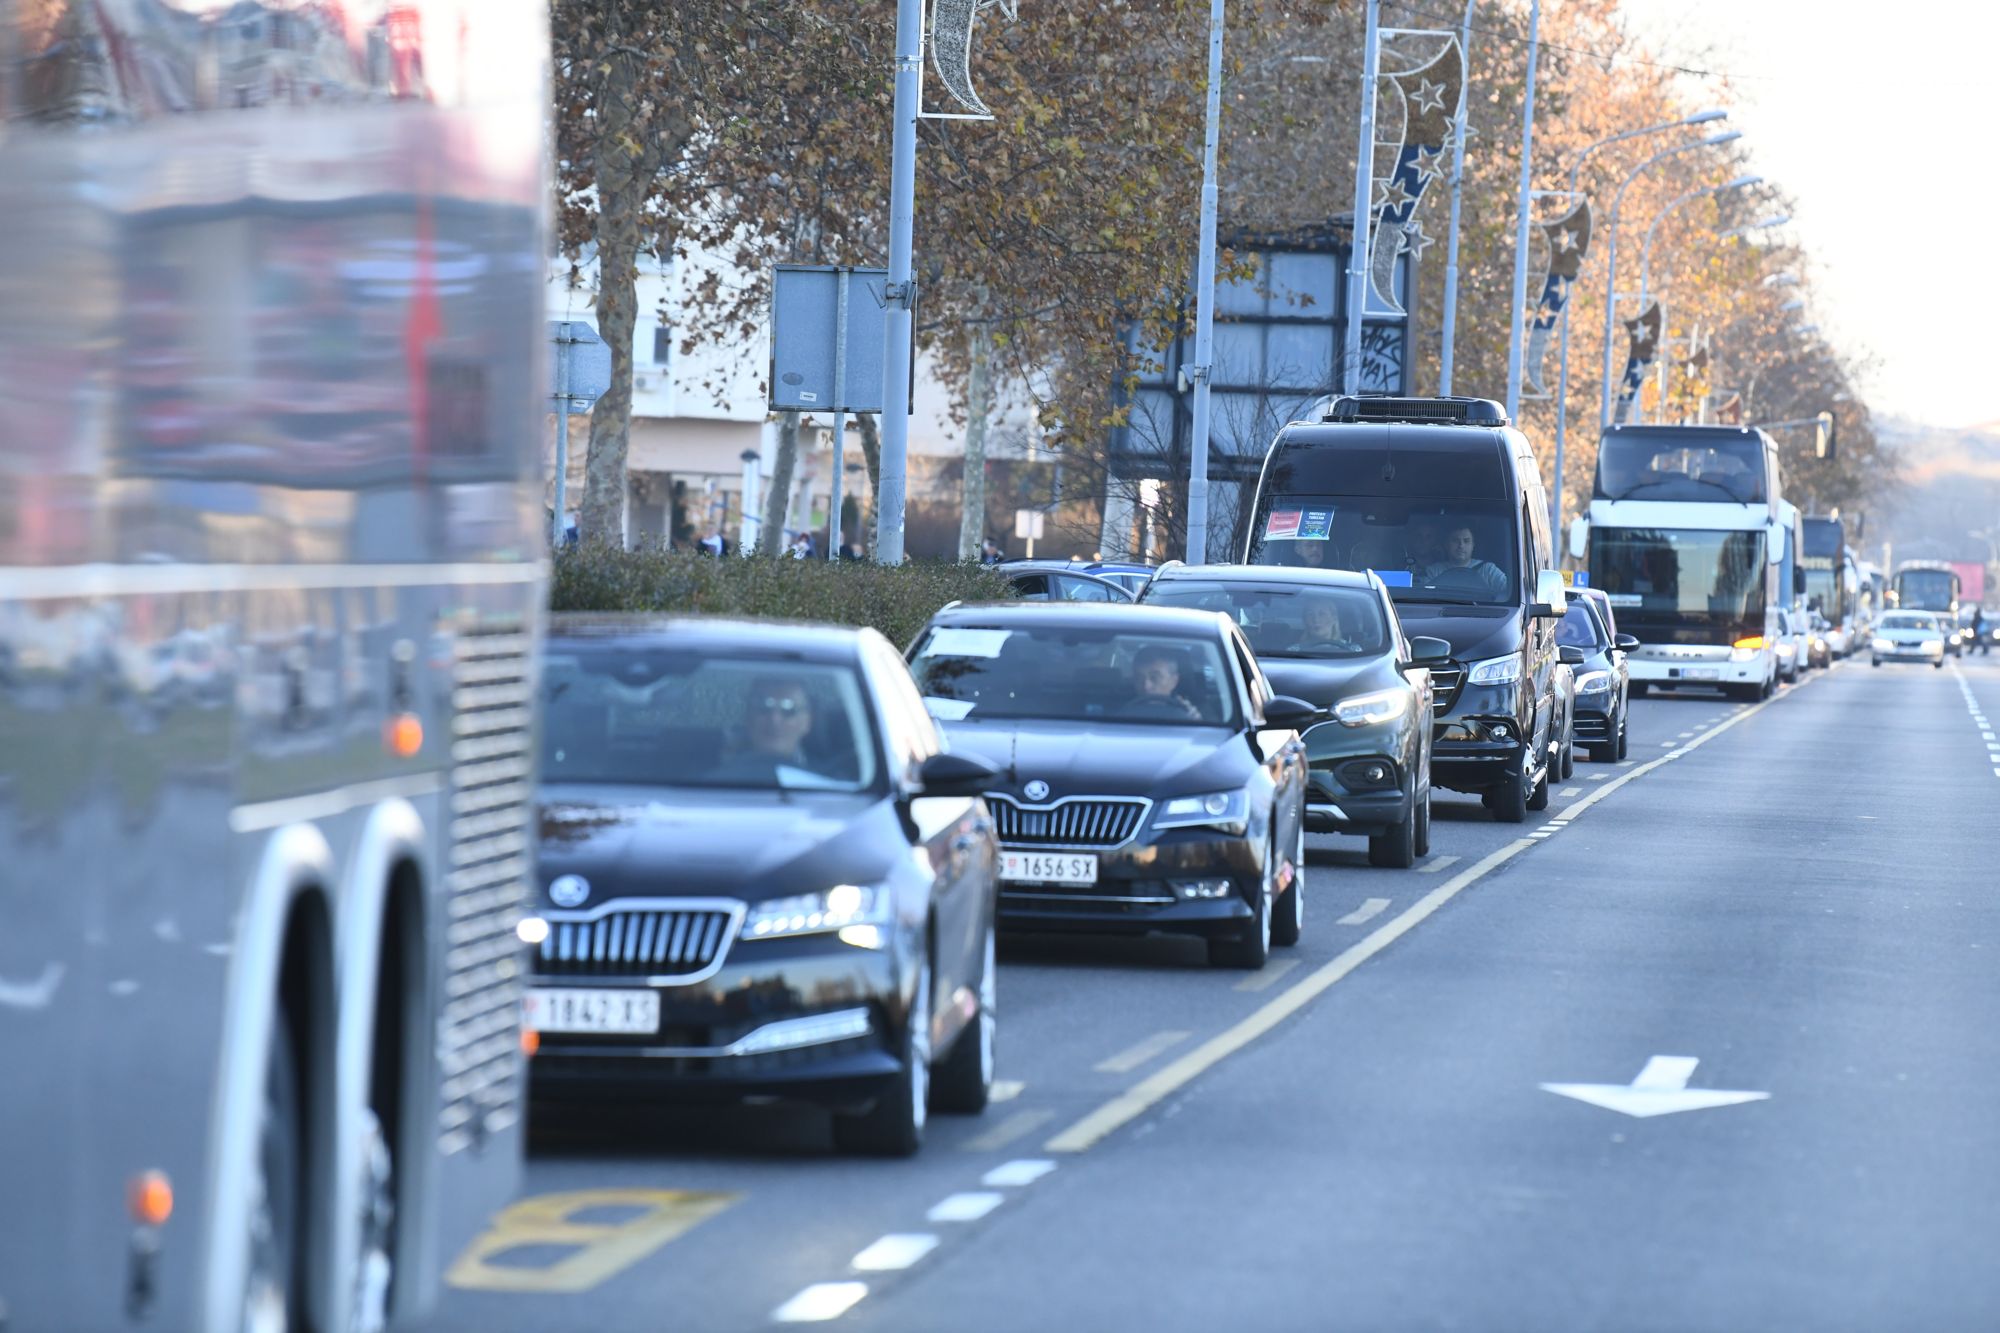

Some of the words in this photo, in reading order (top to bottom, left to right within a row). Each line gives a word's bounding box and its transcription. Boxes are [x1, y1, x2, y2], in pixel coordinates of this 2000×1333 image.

[1577, 573, 1585, 586] L
[1024, 857, 1064, 877] 1656
[1071, 859, 1092, 878] SX
